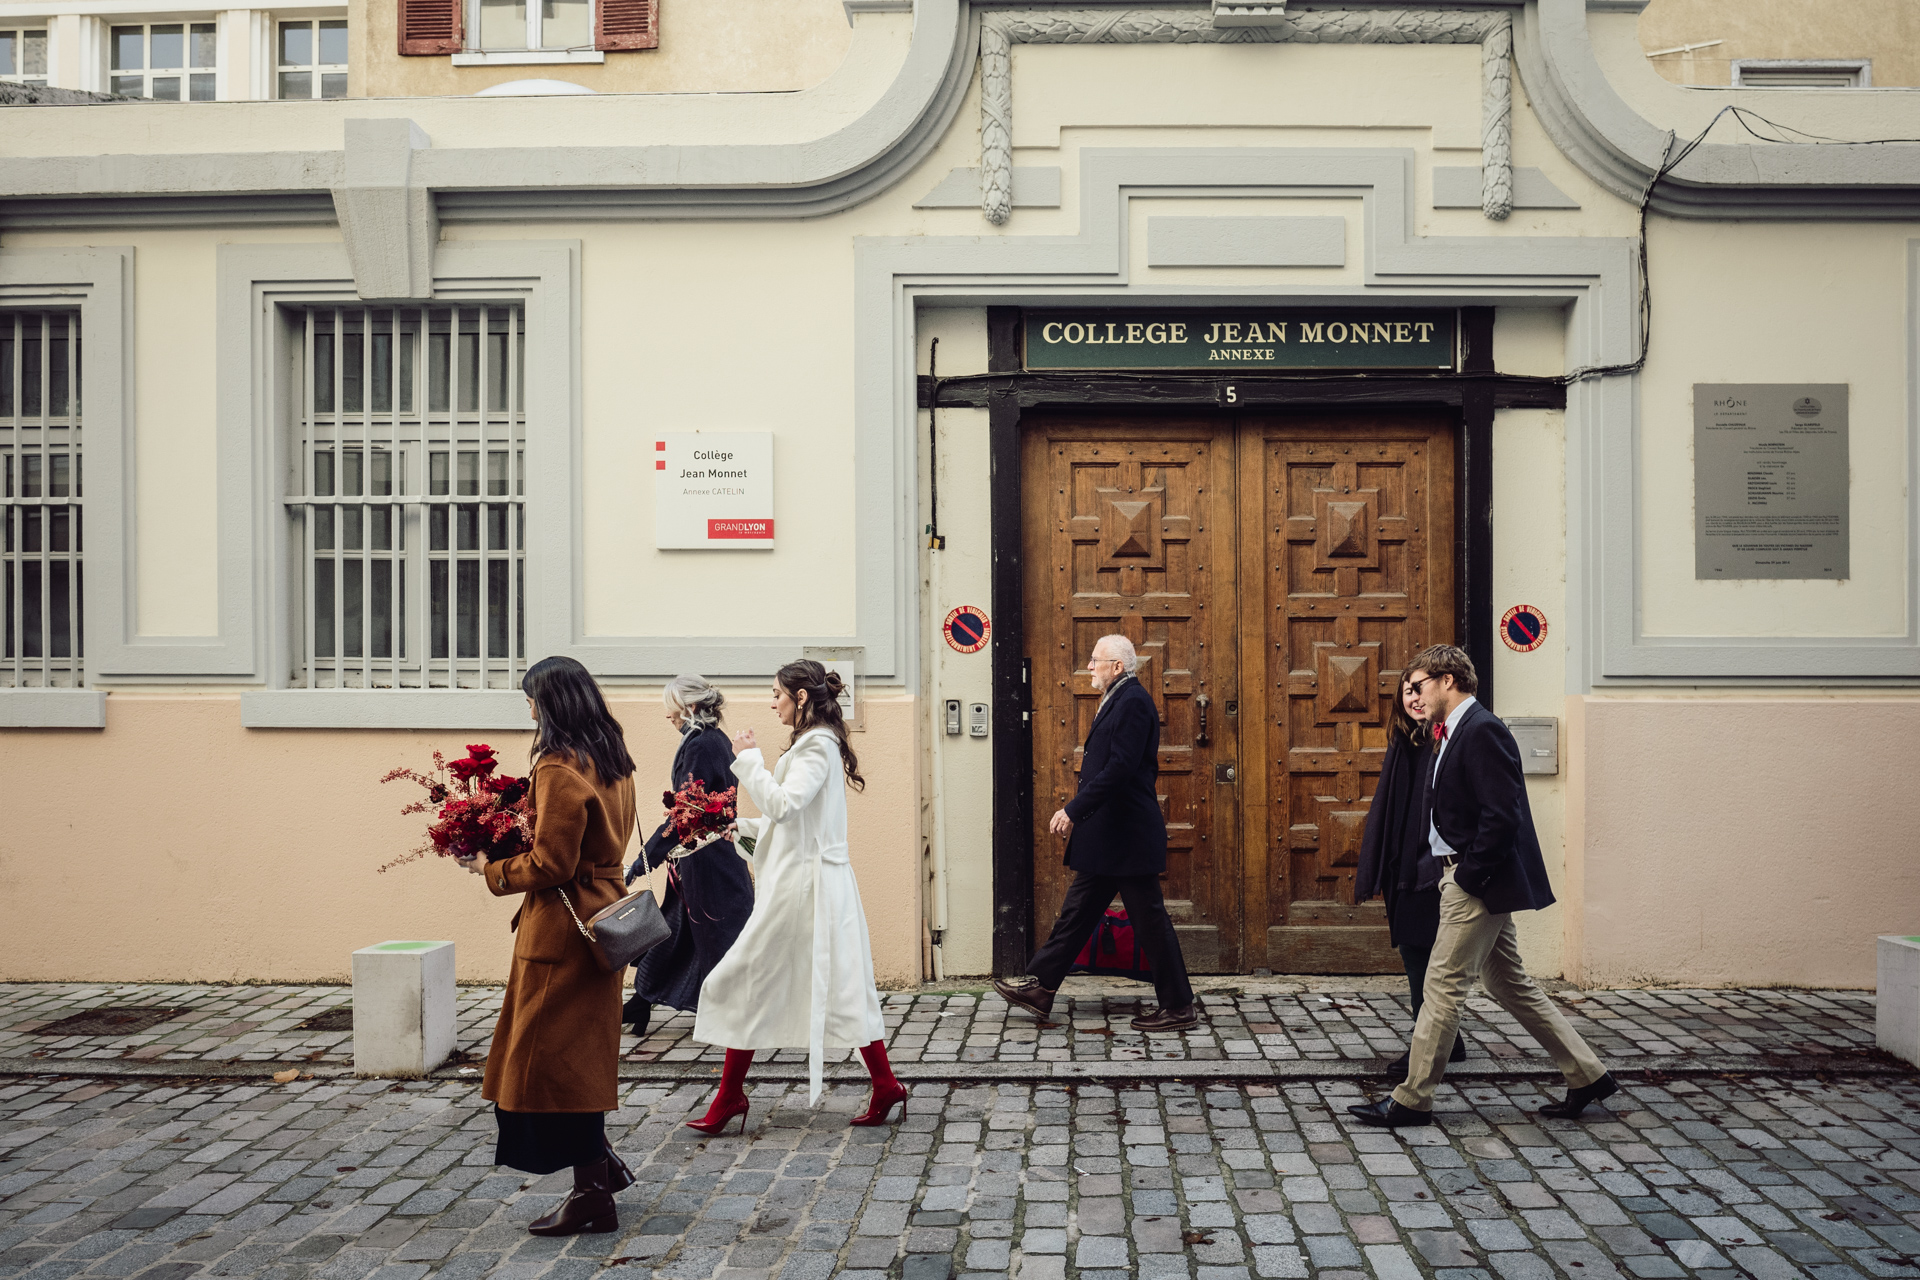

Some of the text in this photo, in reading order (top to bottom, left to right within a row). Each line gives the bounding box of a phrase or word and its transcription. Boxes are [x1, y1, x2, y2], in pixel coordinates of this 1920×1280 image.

[1042, 321, 1435, 344] COLLEGE JEAN MONNET
[1208, 349, 1275, 361] ANNEXE
[1226, 386, 1237, 403] 5
[1713, 397, 1747, 409] RHÔNE
[693, 450, 734, 462] Collège
[679, 469, 748, 478] Jean Monnet
[958, 606, 965, 614] DE
[1518, 605, 1525, 613] DE
